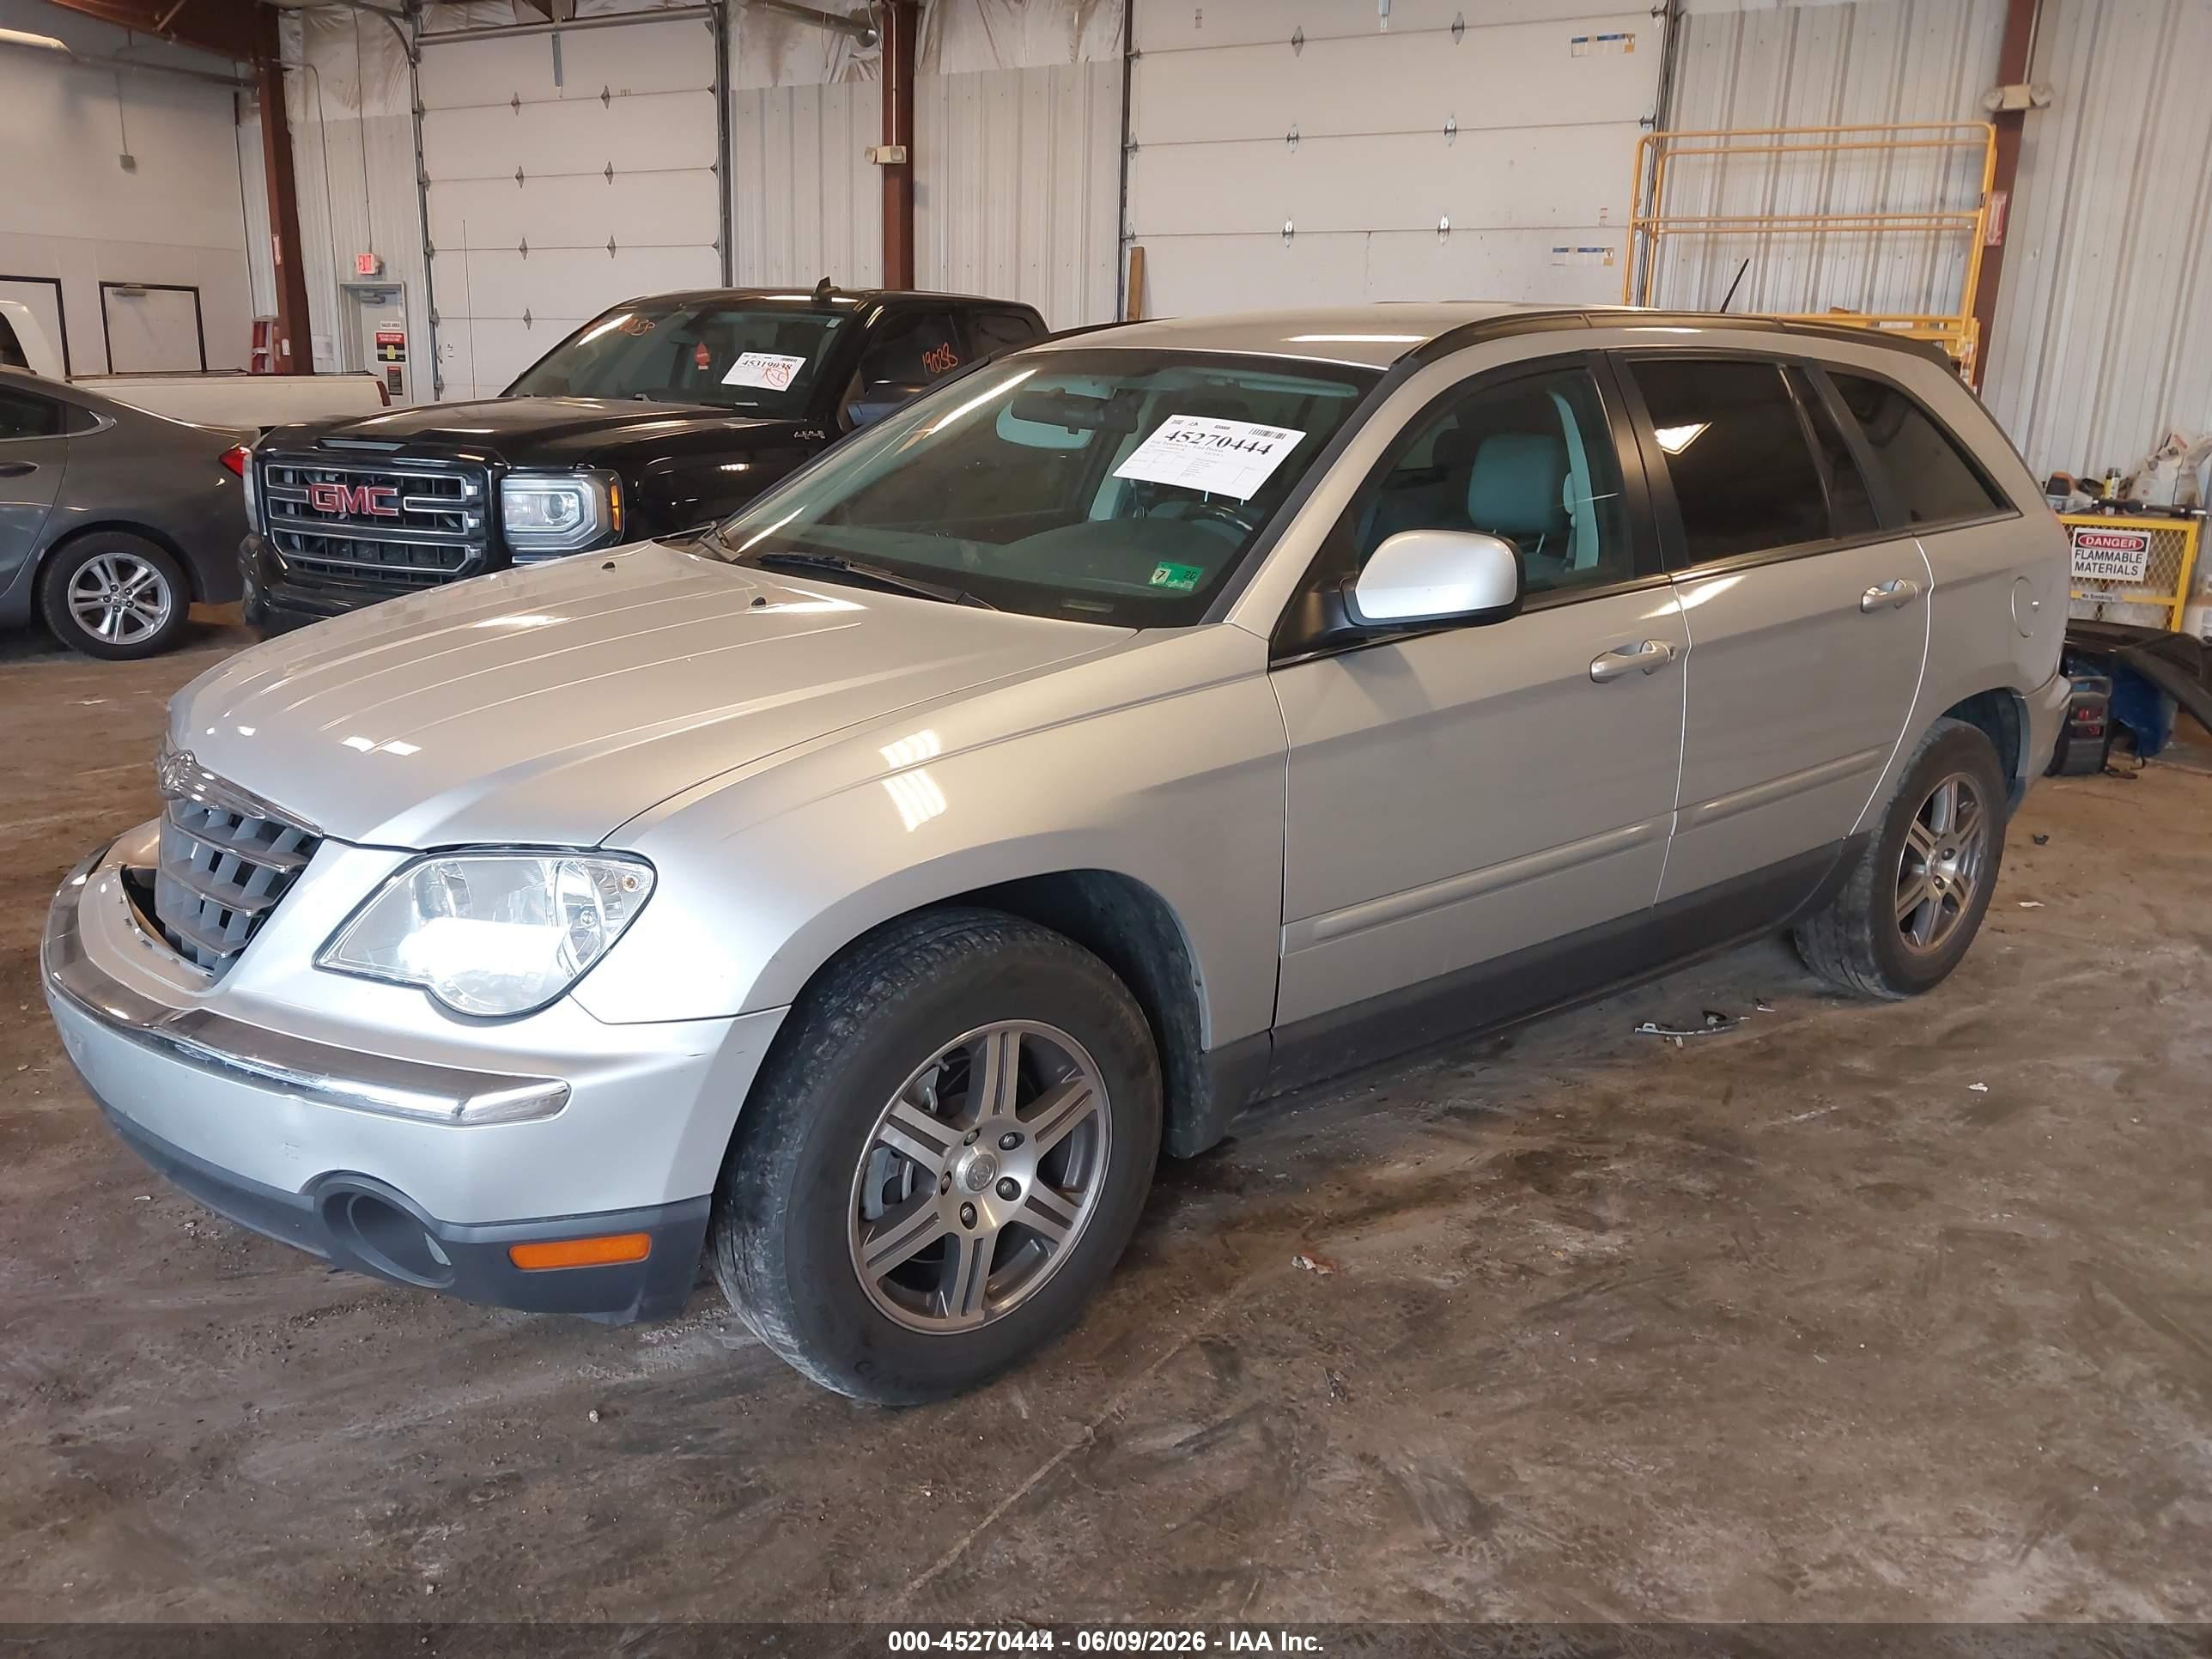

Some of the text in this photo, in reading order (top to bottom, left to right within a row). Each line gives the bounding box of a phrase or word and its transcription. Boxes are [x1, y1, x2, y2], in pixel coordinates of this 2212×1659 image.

[1164, 430, 1274, 455] 45270444
[311, 483, 399, 516] GMC
[2086, 537, 2137, 548] DANGER
[2075, 550, 2143, 564] FLAMMABLE
[1156, 569, 1166, 580] 7
[2075, 562, 2139, 576] MATERIALS
